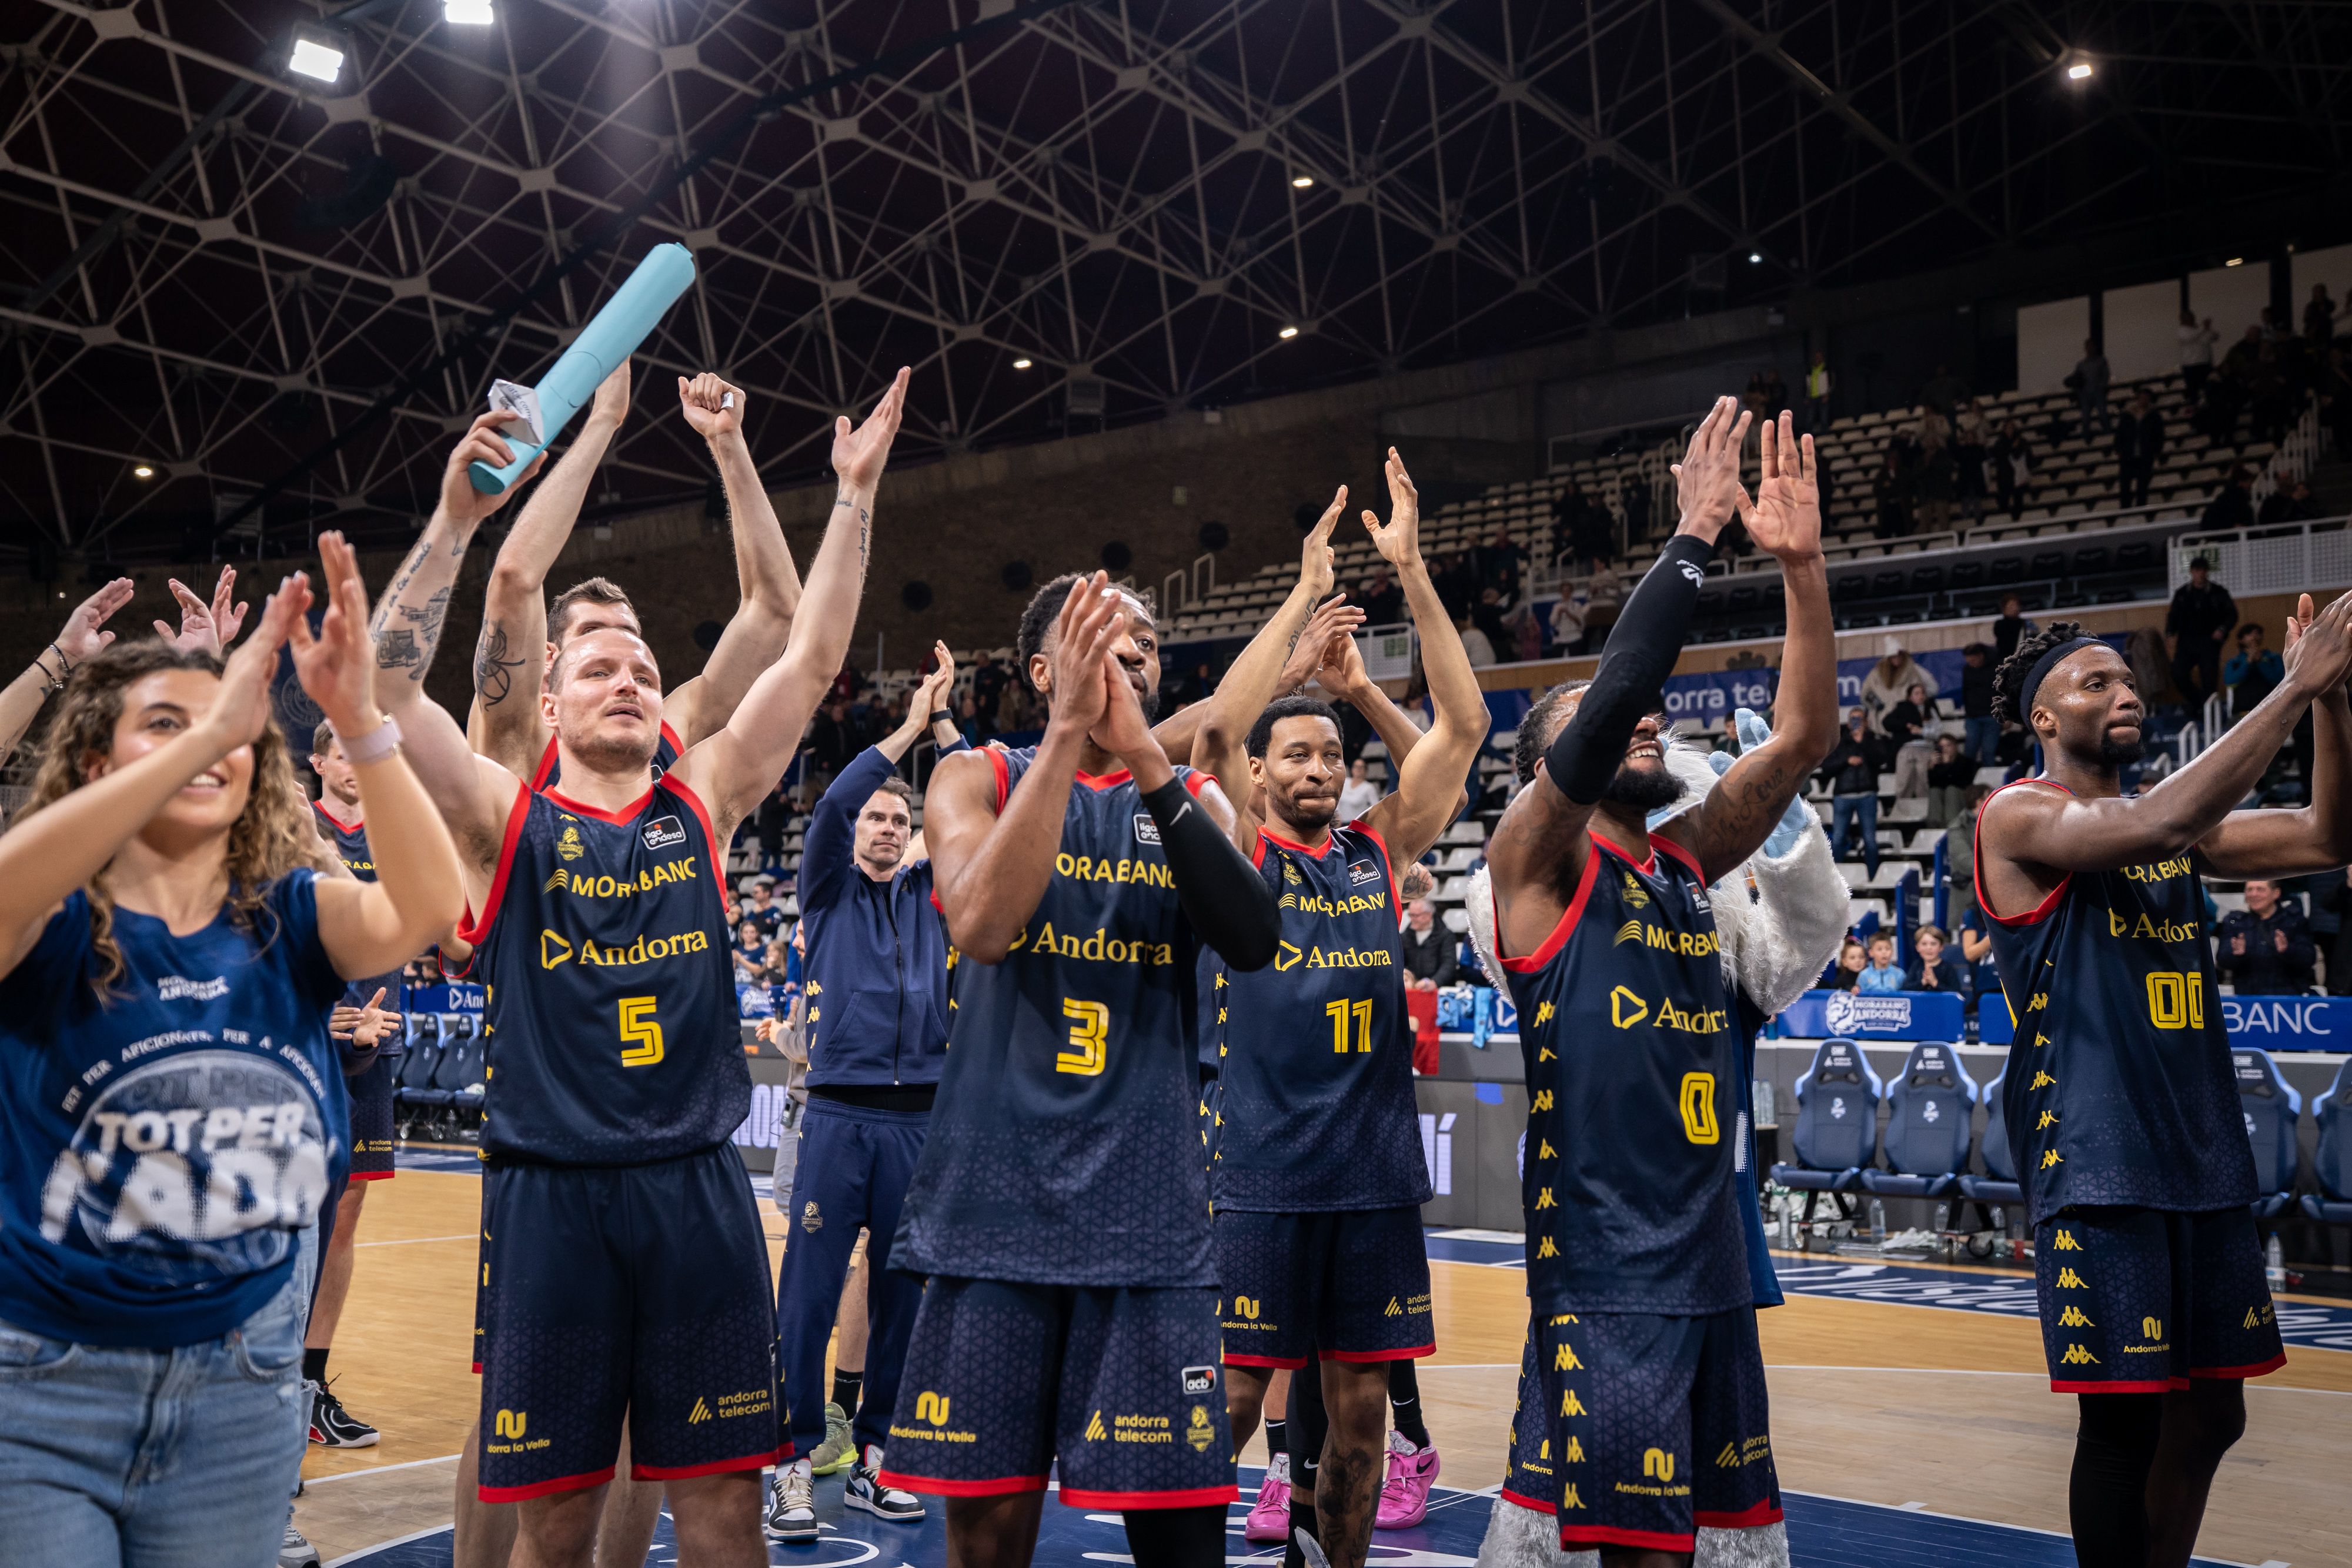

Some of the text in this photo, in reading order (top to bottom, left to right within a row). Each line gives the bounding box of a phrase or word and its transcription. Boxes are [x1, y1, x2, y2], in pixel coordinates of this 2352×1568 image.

[1665, 687, 1726, 713] orra
[644, 828, 663, 840] liga
[649, 831, 683, 845] endesa
[572, 857, 697, 898] MORABANC
[1056, 852, 1176, 889] ORABANC
[1352, 871, 1378, 882] endesa
[1300, 892, 1385, 917] MORABAN
[579, 929, 709, 967] Andorra
[1031, 921, 1173, 966] Andorra
[1306, 945, 1392, 969] Andorra
[2146, 972, 2204, 1029] 00
[619, 995, 665, 1067] 5
[1326, 998, 1372, 1053] 11
[223, 1028, 251, 1045] PER
[259, 1036, 272, 1049] A
[1056, 997, 1110, 1076] 3
[1680, 1072, 1720, 1145] 0
[94, 1102, 306, 1154] TOT PER
[1220, 1320, 1248, 1329] ndorra
[1259, 1323, 1278, 1331] Vella
[2124, 1345, 2157, 1353] Andorra
[1187, 1377, 1210, 1390] acb
[718, 1389, 768, 1406] andorra
[719, 1400, 771, 1419] telecom
[1114, 1414, 1170, 1428] andorra
[888, 1424, 977, 1443] Andorra la Vella
[1114, 1429, 1172, 1443] telecom
[487, 1439, 551, 1453] dorra la Vella
[1522, 1460, 1553, 1476] Andorra
[1615, 1482, 1662, 1496] Andorra
[1663, 1487, 1673, 1496] la
